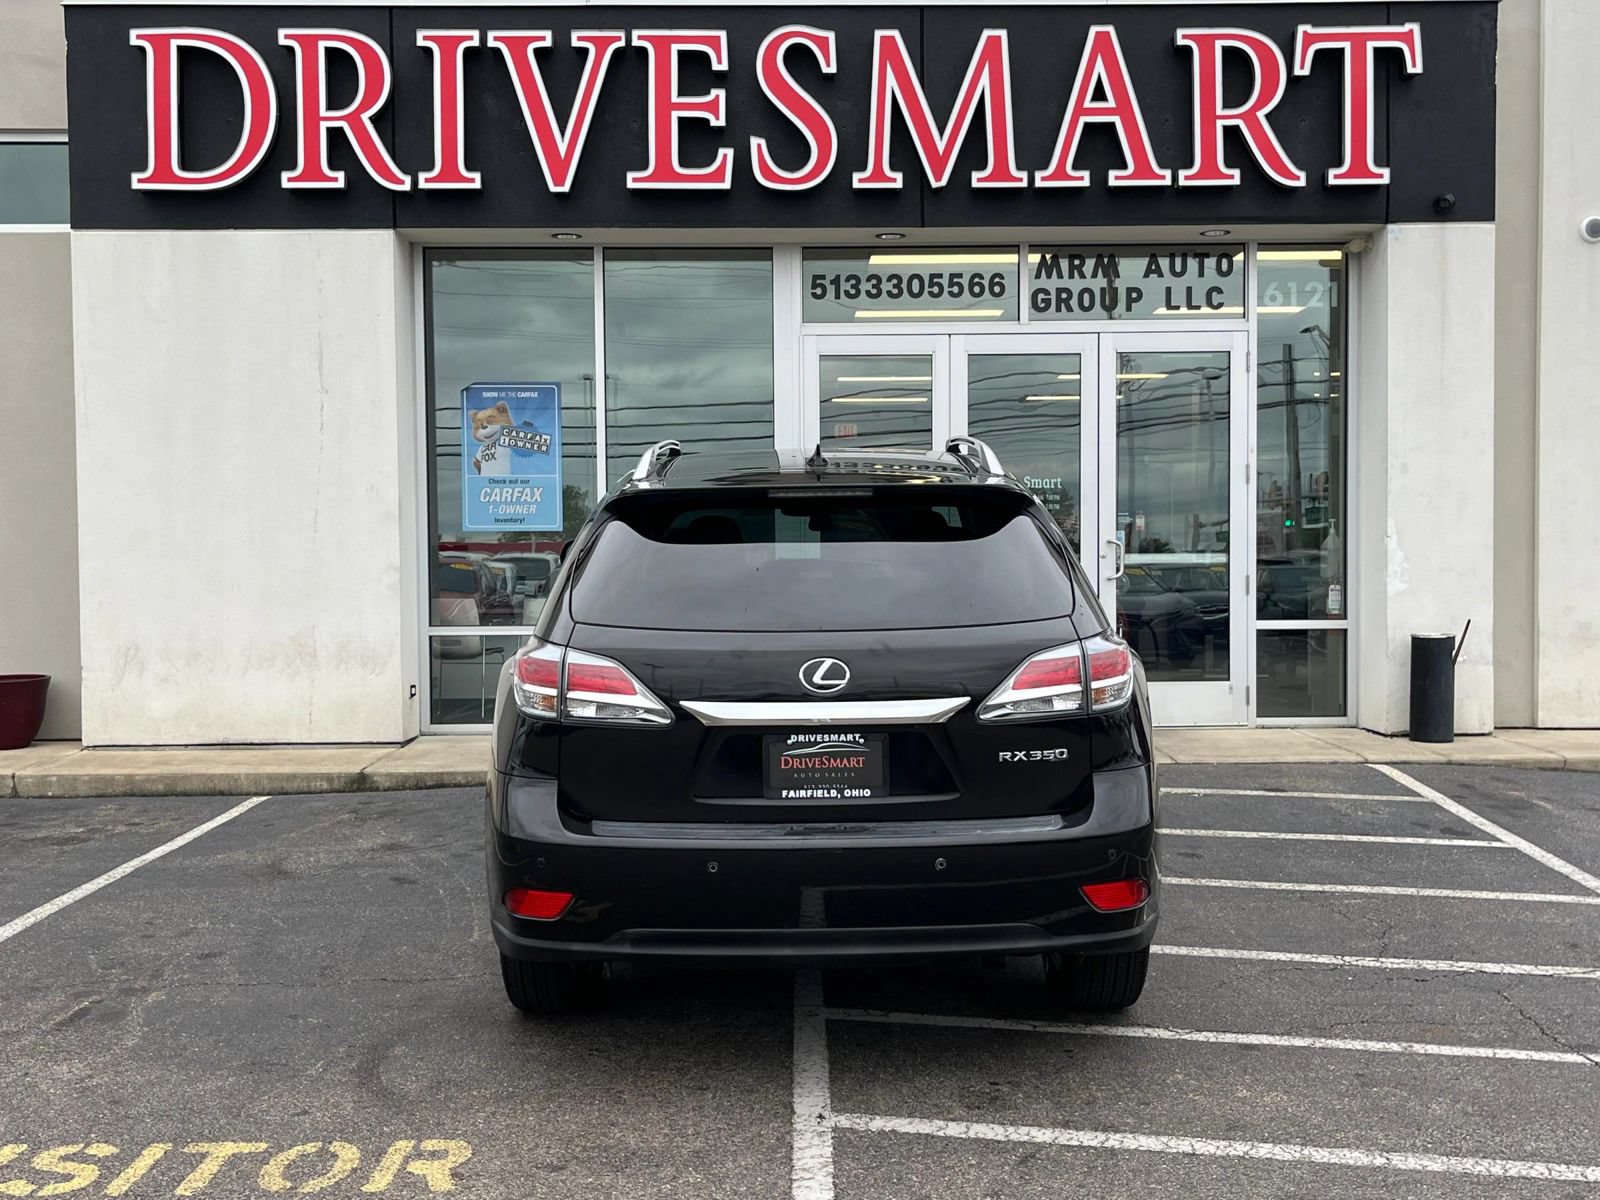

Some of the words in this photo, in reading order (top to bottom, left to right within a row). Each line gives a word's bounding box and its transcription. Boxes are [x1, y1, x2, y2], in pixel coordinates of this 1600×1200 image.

[128, 23, 1424, 192] DRIVESMART
[1034, 253, 1121, 280] MRM
[1143, 252, 1234, 278] AUTO
[810, 272, 1006, 300] 5133305566
[1031, 286, 1143, 313] GROUP
[1164, 285, 1225, 311] LLC
[1263, 281, 1338, 307] 6121
[503, 429, 550, 444] CARFAX
[1023, 475, 1062, 489] Smart
[480, 487, 544, 502] CARFAX
[489, 504, 537, 514] 1-OWNER
[790, 733, 861, 742] DRIVESMART
[782, 789, 841, 799] FAIRFIELD,
[843, 788, 872, 798] OHIO
